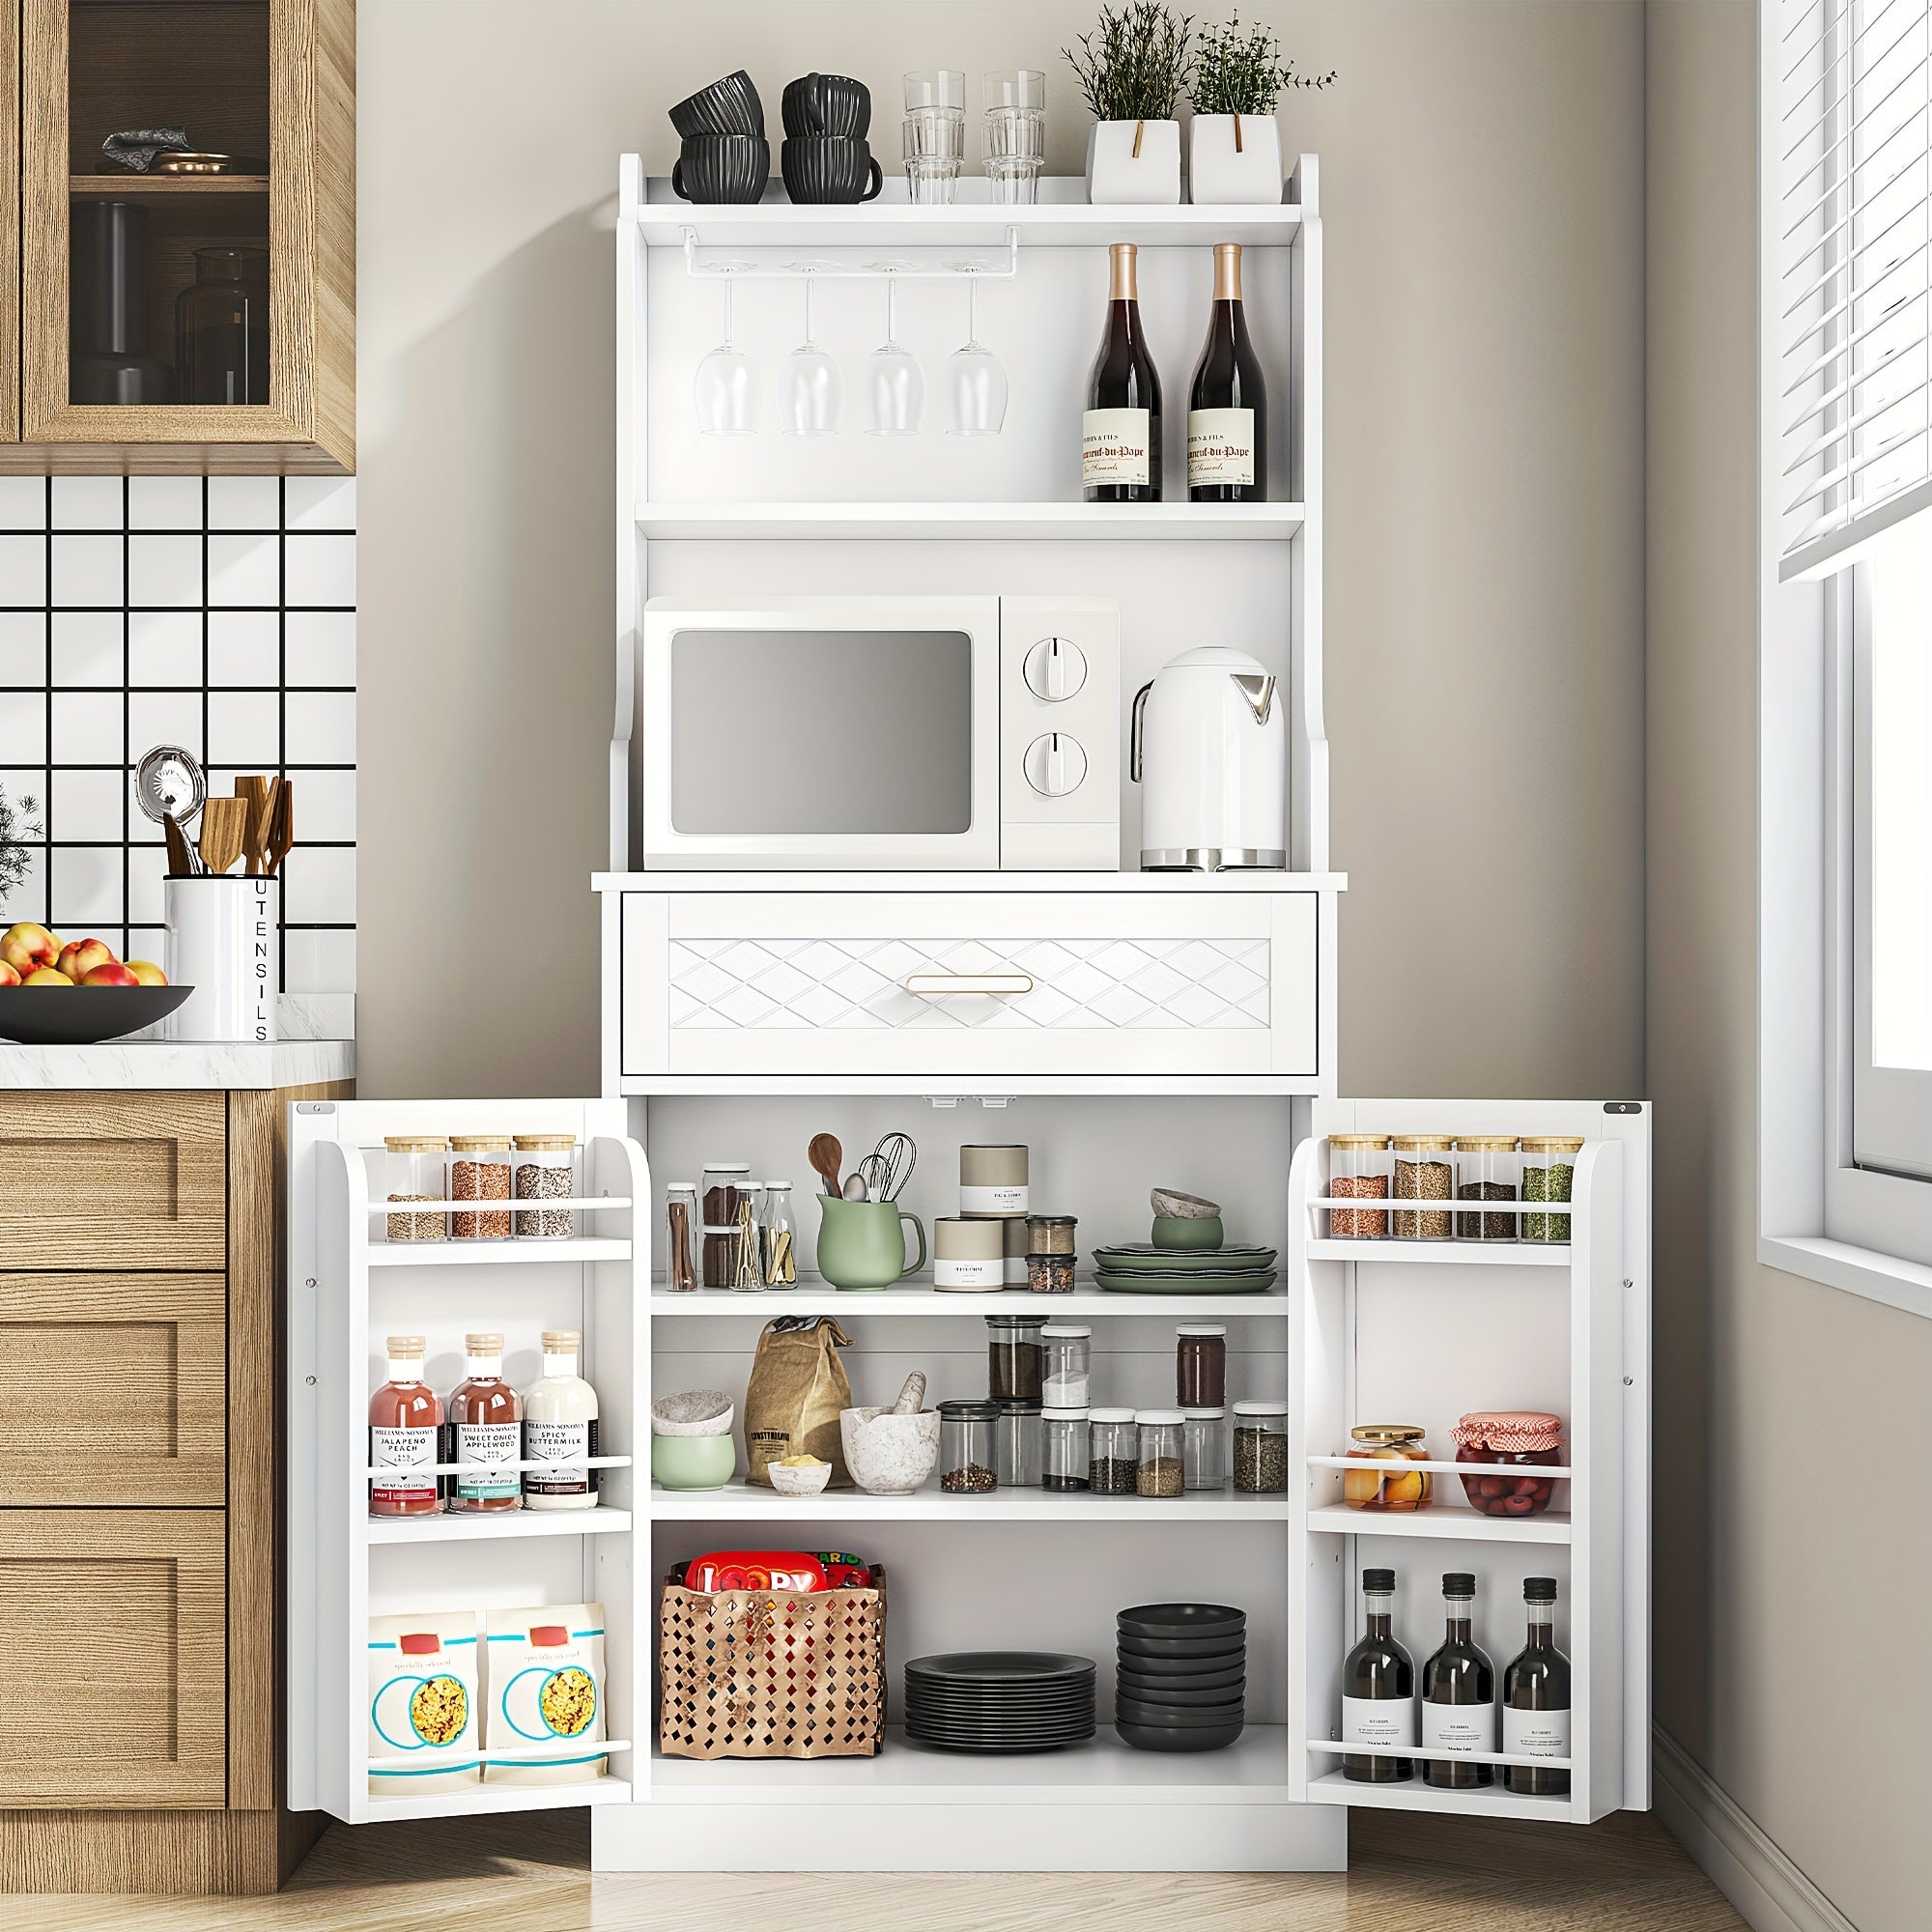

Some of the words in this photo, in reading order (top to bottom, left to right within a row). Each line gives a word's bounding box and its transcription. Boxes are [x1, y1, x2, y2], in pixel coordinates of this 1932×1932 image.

[255, 880, 267, 1040] UTENSILS
[819, 1552, 859, 1564] ARIO
[702, 1567, 813, 1593] LOOPY
